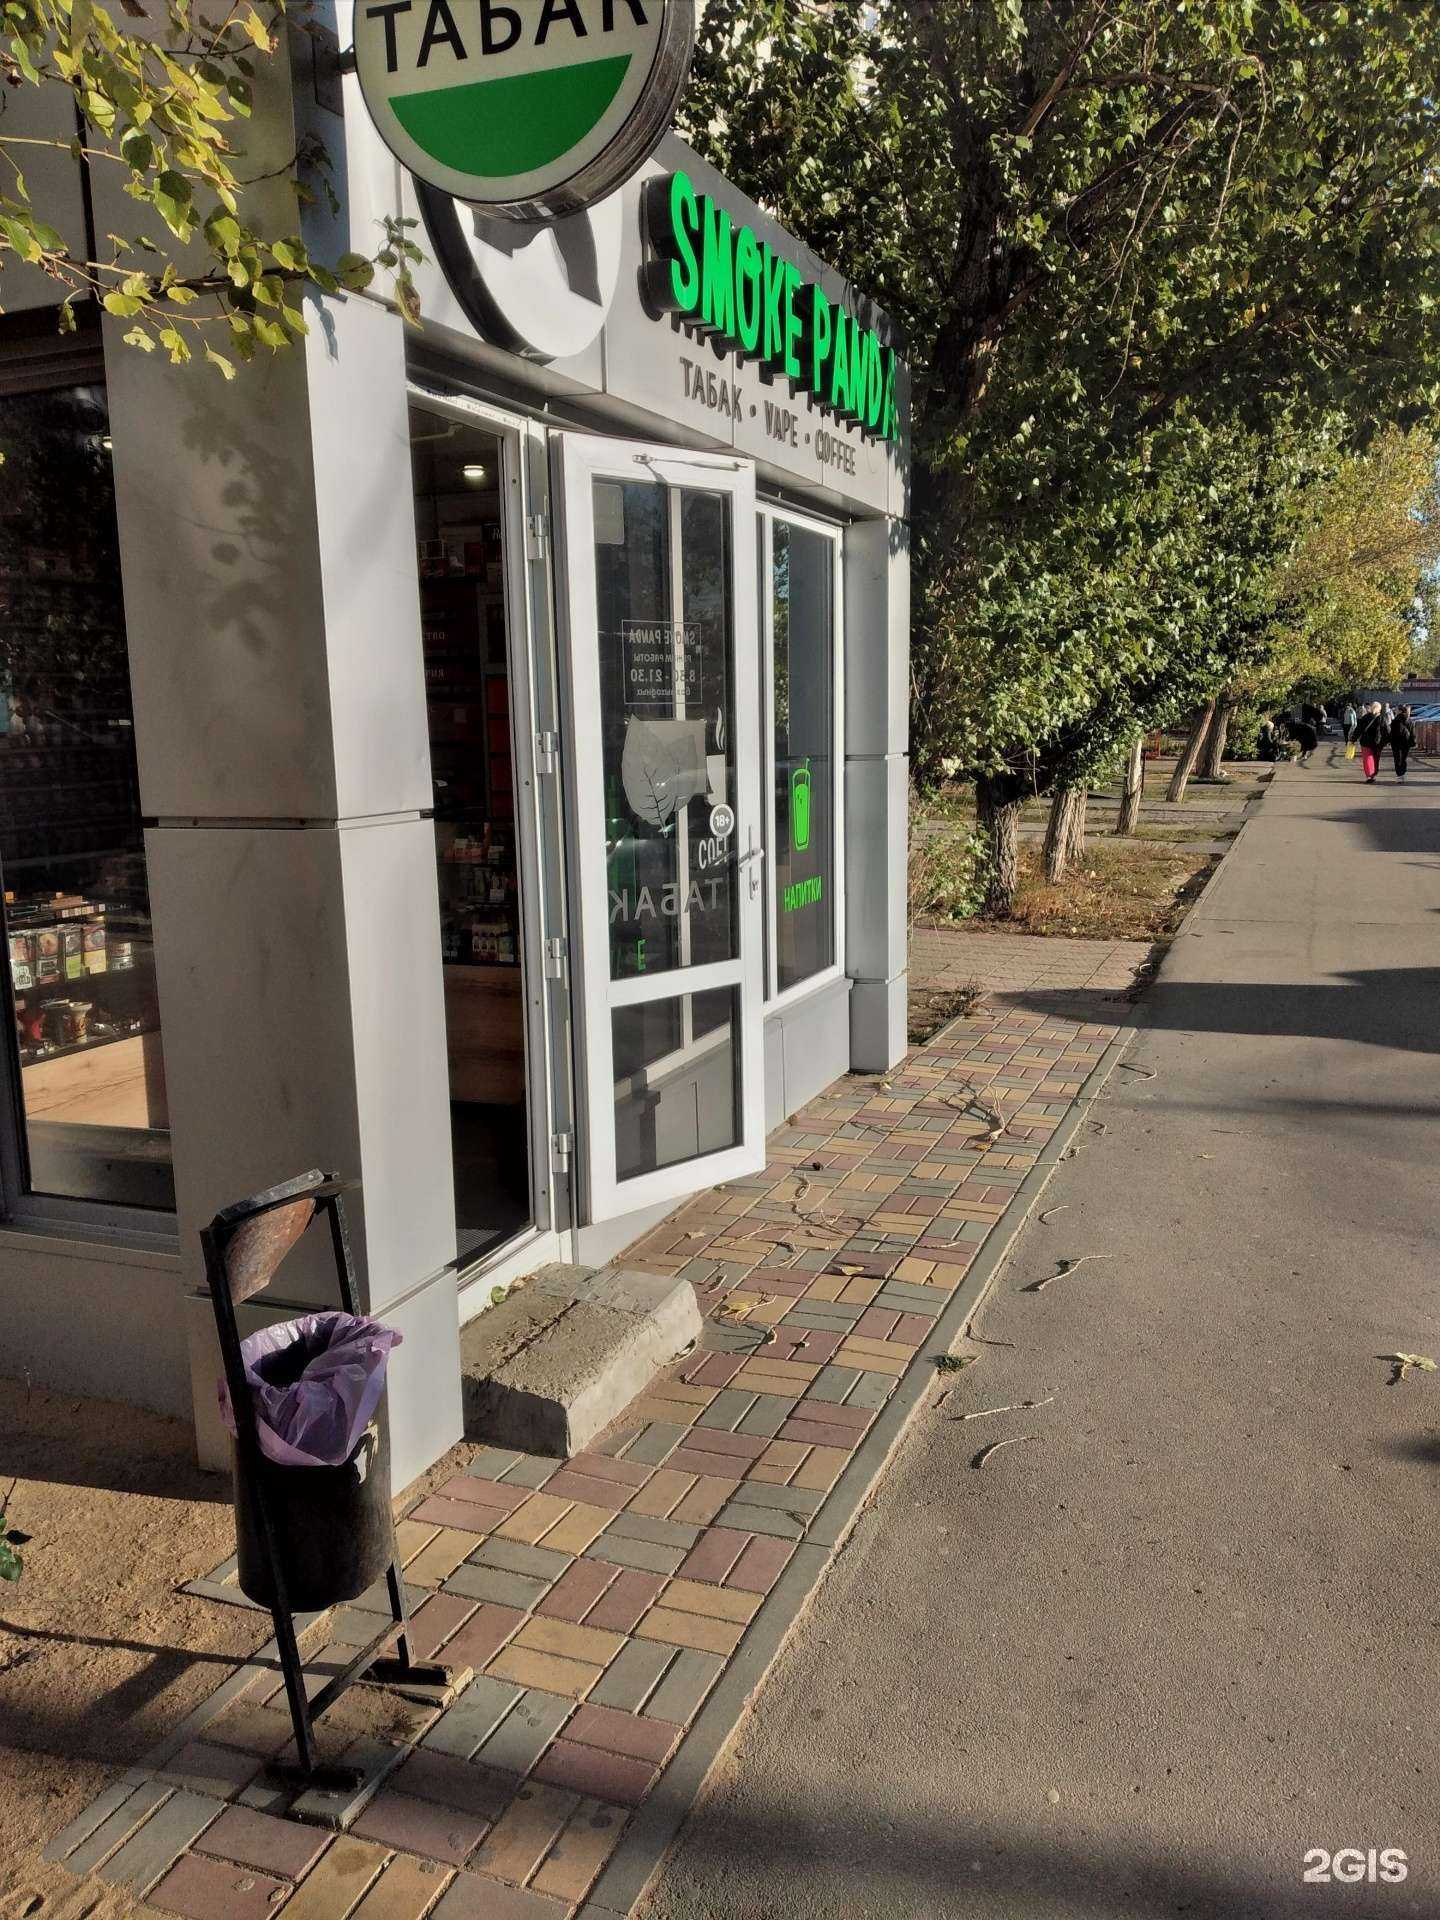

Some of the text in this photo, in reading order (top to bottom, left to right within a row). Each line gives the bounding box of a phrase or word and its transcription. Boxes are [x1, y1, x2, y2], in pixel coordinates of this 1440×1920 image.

[670, 169, 898, 441] SMOKE PANDA
[679, 356, 857, 477] ТАБАК VAPE COFFEE
[715, 814, 730, 828] 18+
[784, 875, 822, 913] НАПИТКИ
